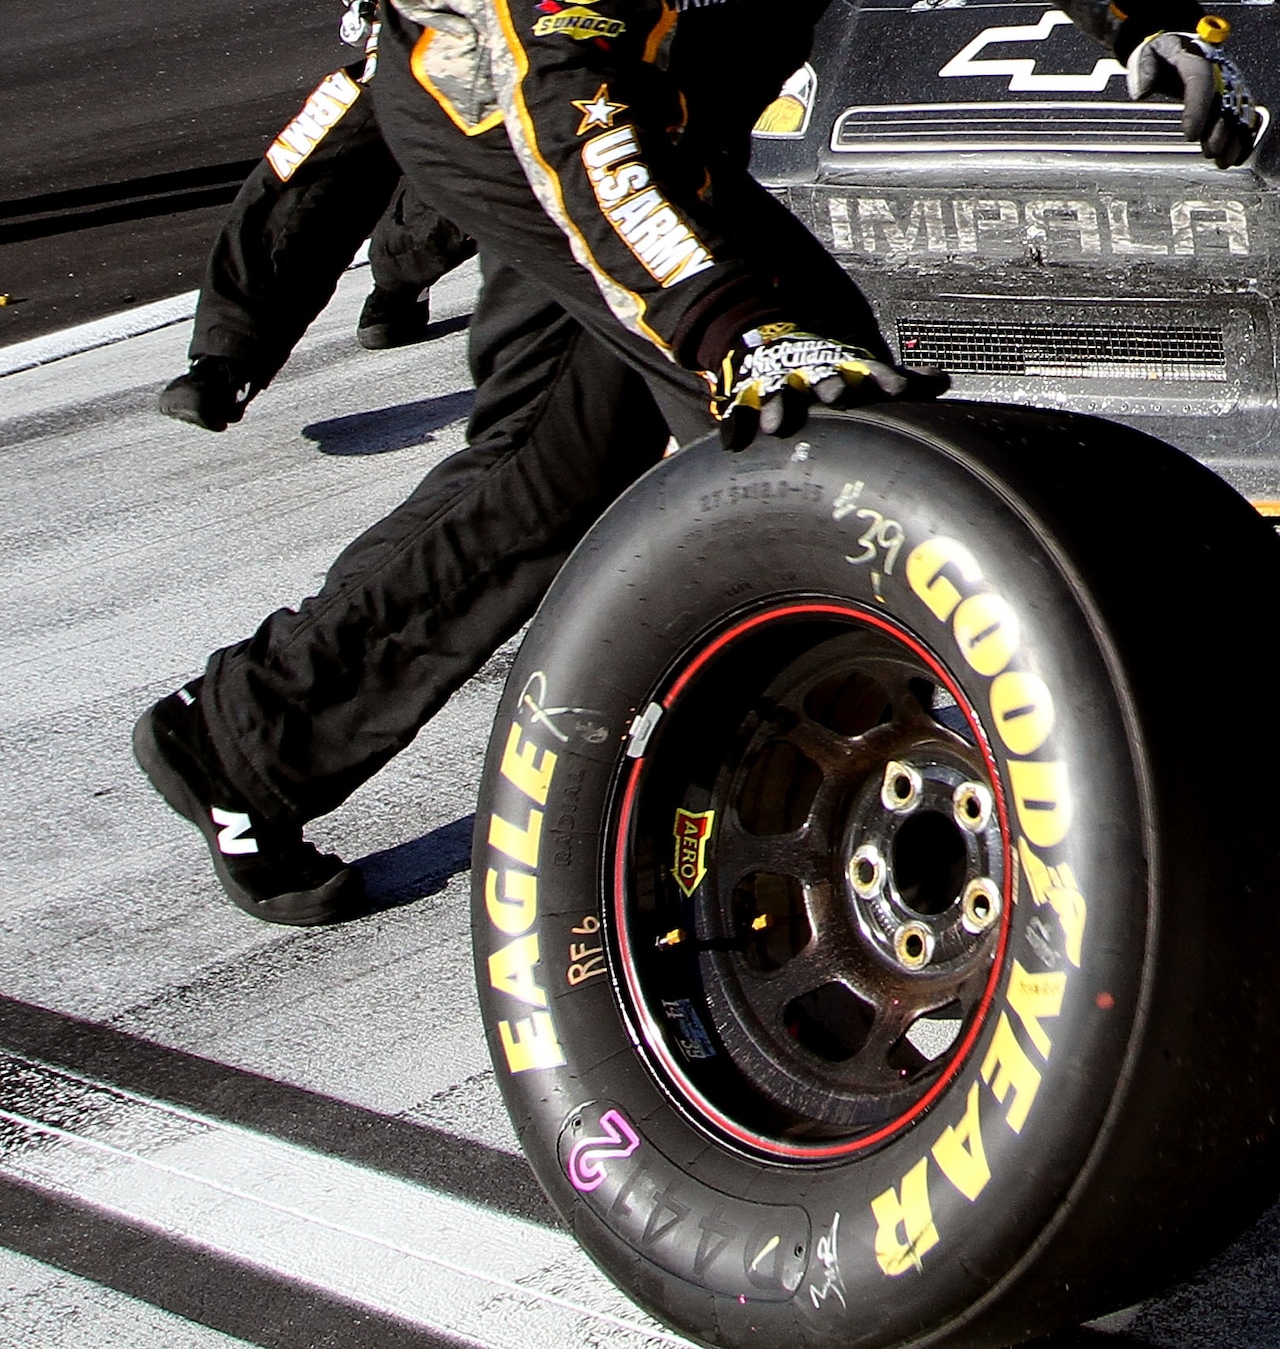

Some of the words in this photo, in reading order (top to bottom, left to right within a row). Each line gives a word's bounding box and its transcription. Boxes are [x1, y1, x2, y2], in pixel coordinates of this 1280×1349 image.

[539, 14, 622, 35] SUNOCO
[266, 69, 361, 182] ARMY
[583, 126, 652, 209] U.S.
[607, 185, 716, 288] ARMY
[828, 197, 1250, 255] IMPALA
[681, 820, 700, 881] AERO
[484, 721, 567, 1076] EAGLE
[870, 536, 1084, 1276] GOODYEAR
